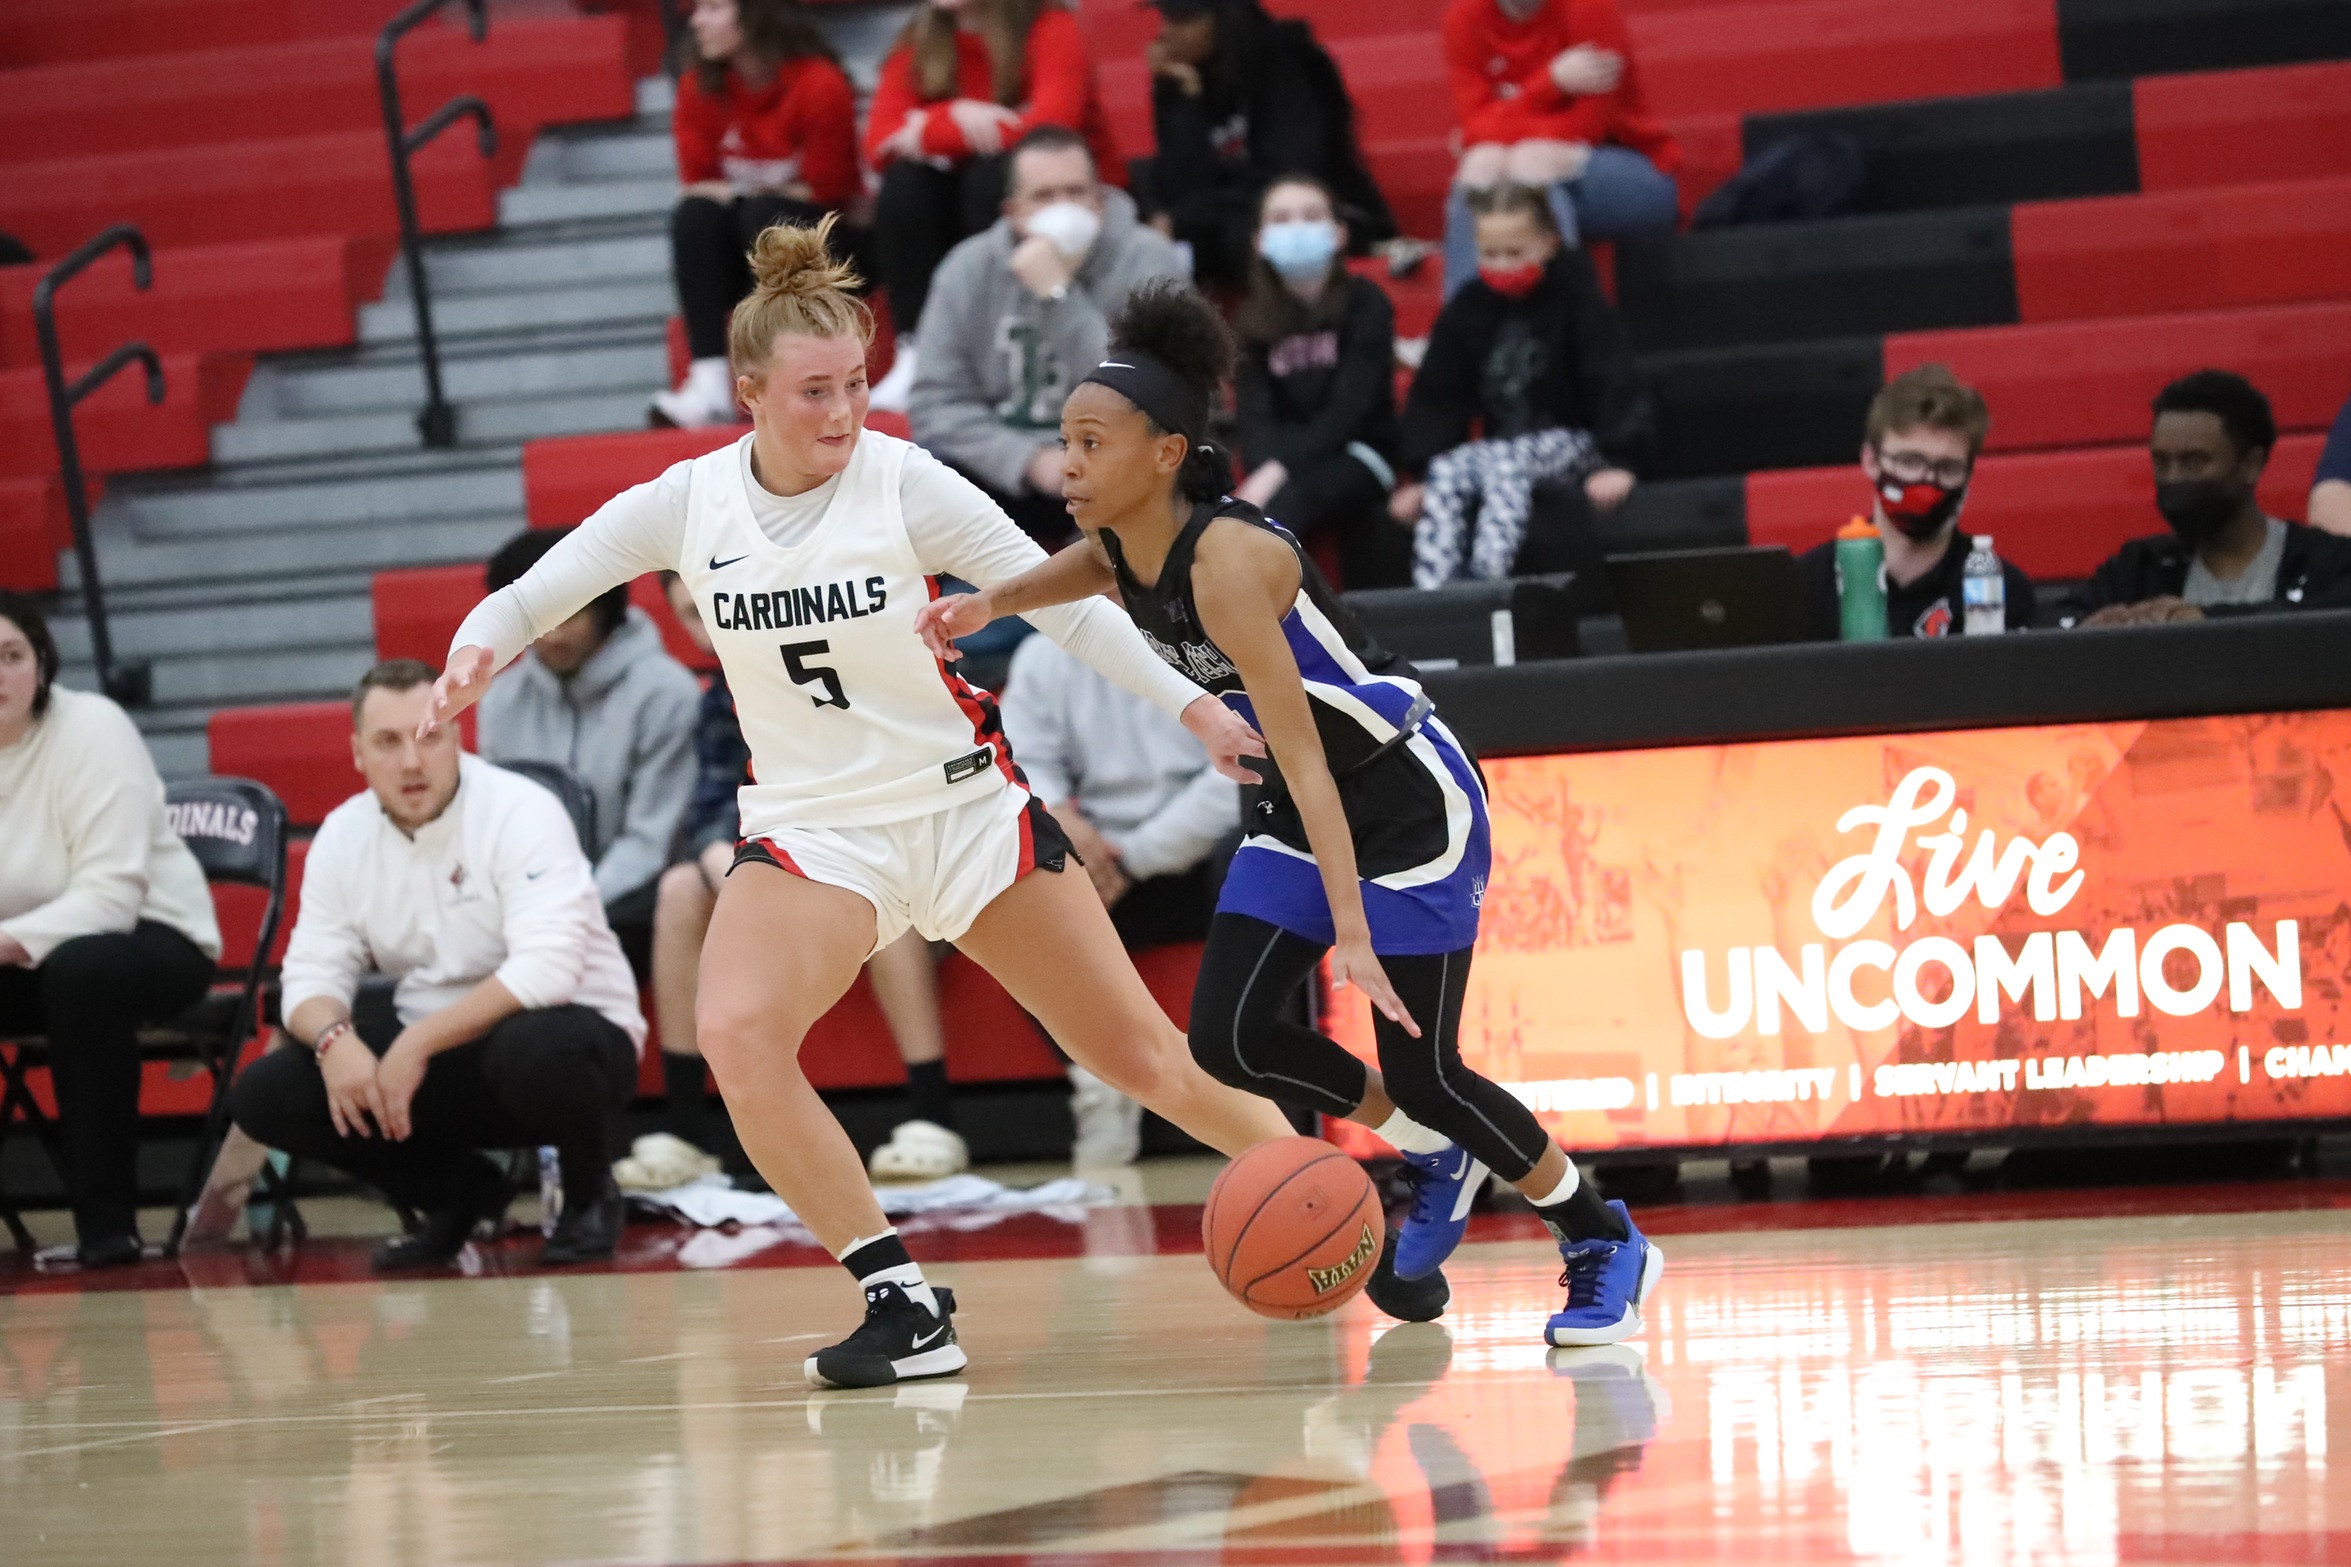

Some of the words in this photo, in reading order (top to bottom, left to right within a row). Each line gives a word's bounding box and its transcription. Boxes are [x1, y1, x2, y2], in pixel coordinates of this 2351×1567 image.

[713, 575, 887, 631] CARDINALS
[779, 638, 851, 710] 5
[978, 755, 988, 767] M
[1812, 765, 2086, 940] Live
[1680, 918, 2303, 1040] UNCOMMON
[1670, 1067, 1836, 1107] INTEGRITY
[1873, 1059, 2020, 1097] SERVANT
[2025, 1050, 2225, 1090] LEADERSHIP
[1305, 1219, 1378, 1295] NAIA
